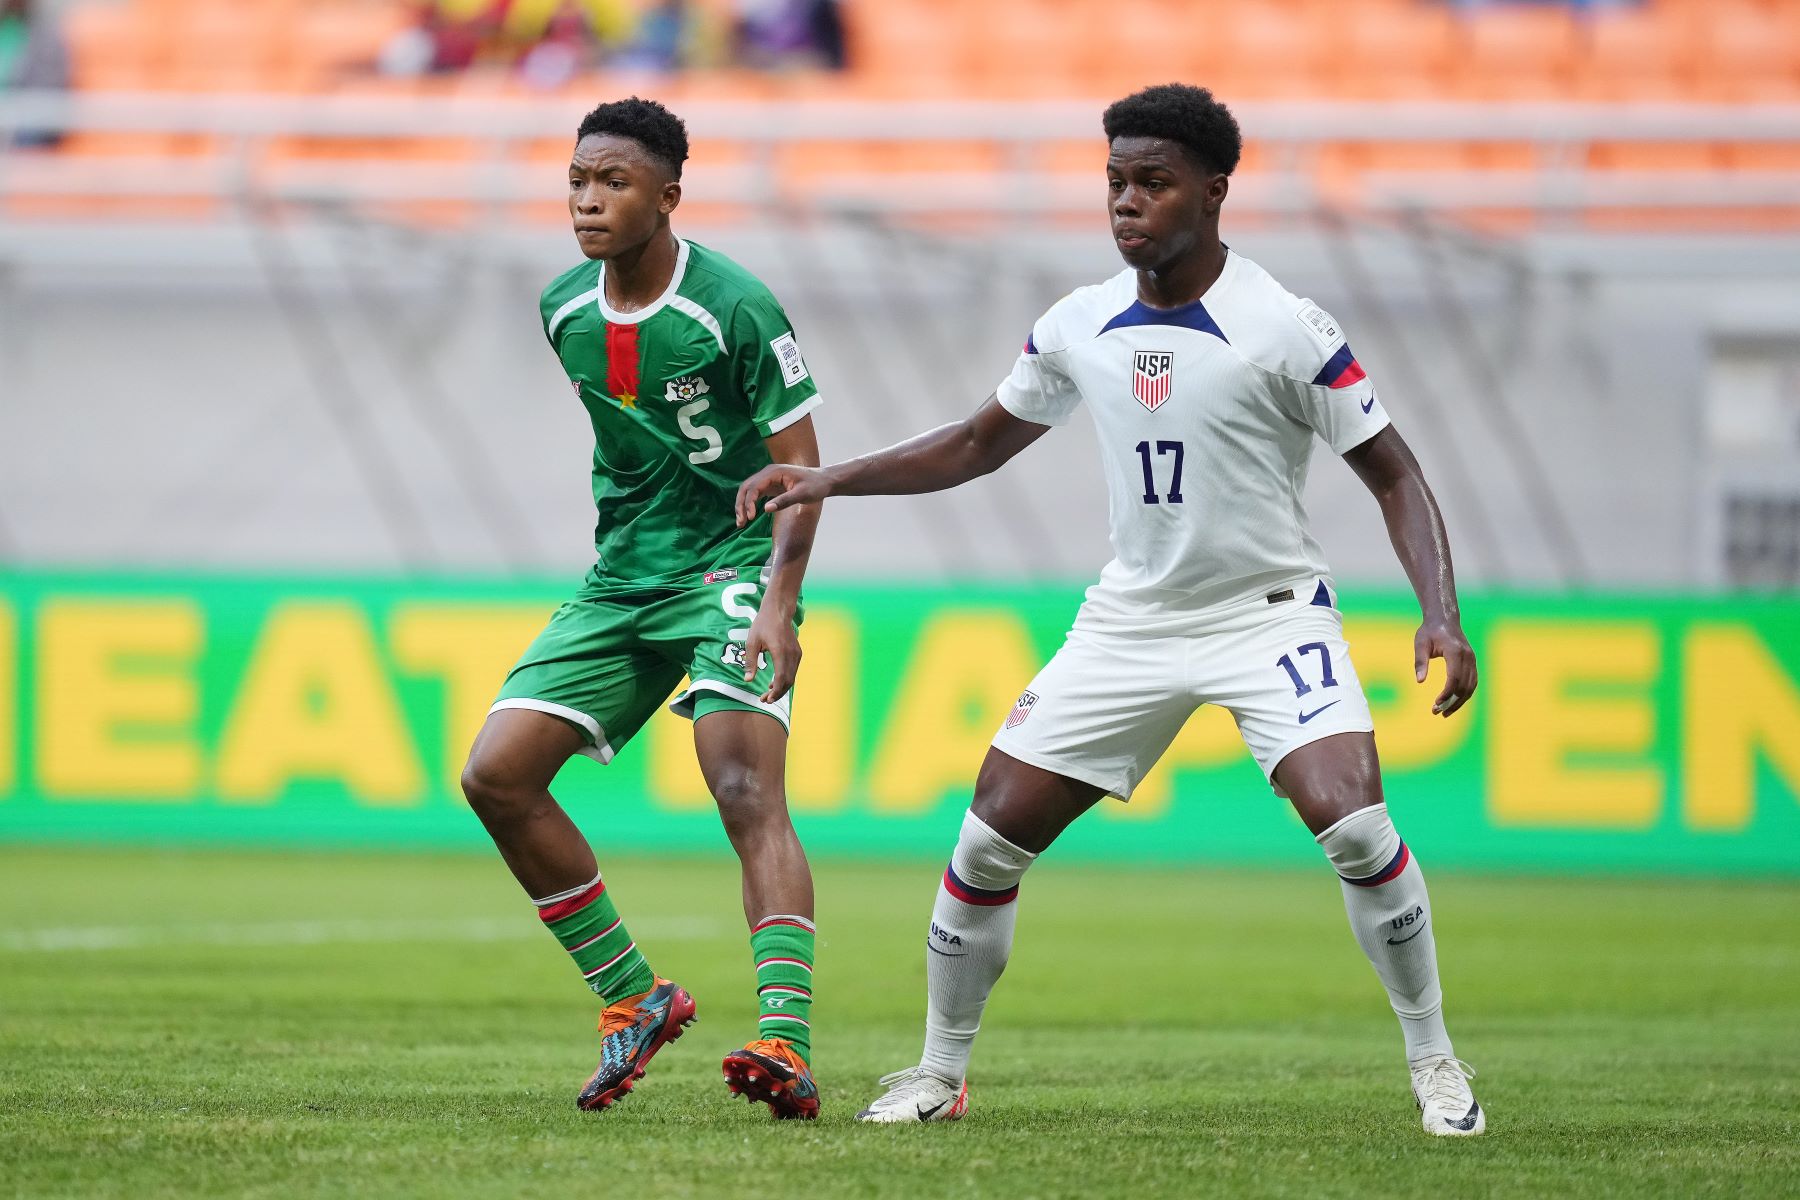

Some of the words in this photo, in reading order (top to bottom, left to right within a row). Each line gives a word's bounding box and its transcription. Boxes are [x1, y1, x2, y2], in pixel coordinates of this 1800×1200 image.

[1137, 355, 1170, 377] USA
[1136, 440, 1184, 504] 17
[1276, 641, 1338, 698] 17
[0, 597, 556, 808] EAT
[931, 921, 961, 946] USA
[1392, 905, 1423, 929] USA
